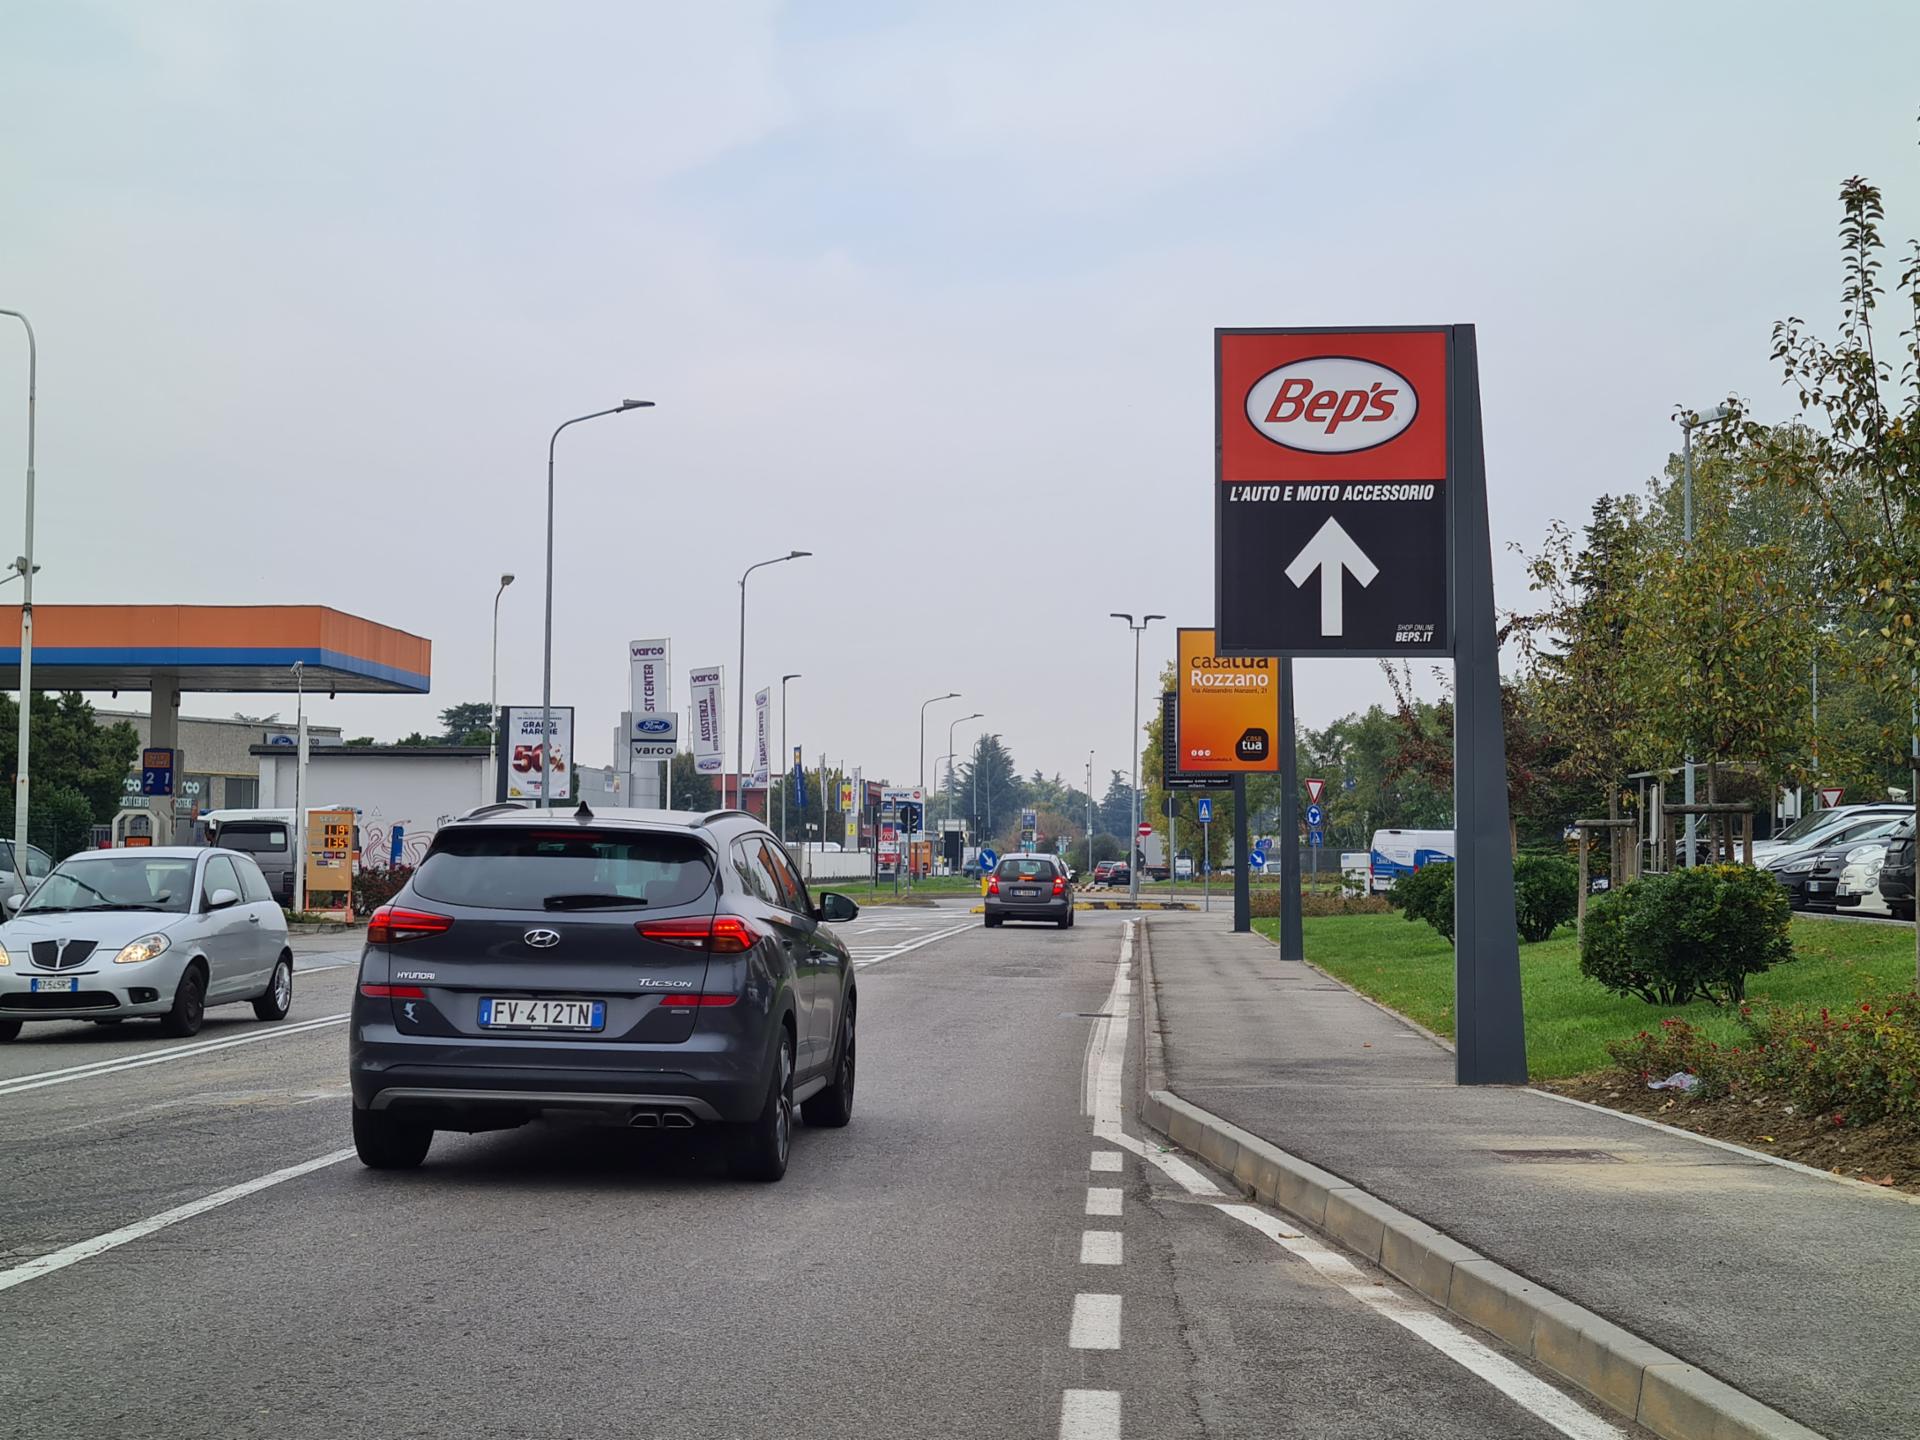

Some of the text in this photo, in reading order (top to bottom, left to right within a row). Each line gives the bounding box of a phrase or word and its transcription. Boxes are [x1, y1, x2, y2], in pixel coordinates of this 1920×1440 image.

[1264, 377, 1400, 435] Bep's
[1229, 484, 1435, 502] L'AUTO E MOTO ACCESSORIO
[1397, 624, 1435, 632] SHOP ONLINE
[1395, 632, 1434, 643] BEPS.IT
[632, 646, 664, 656] varco
[643, 664, 655, 697] CENTER
[691, 673, 719, 683] varco
[1190, 670, 1269, 687] Rozzano
[698, 699, 711, 741] ASSISTENZA
[1242, 740, 1263, 750] tua
[635, 747, 673, 755] varco
[145, 772, 170, 784] 2 1
[397, 971, 436, 980] HYUNDAI
